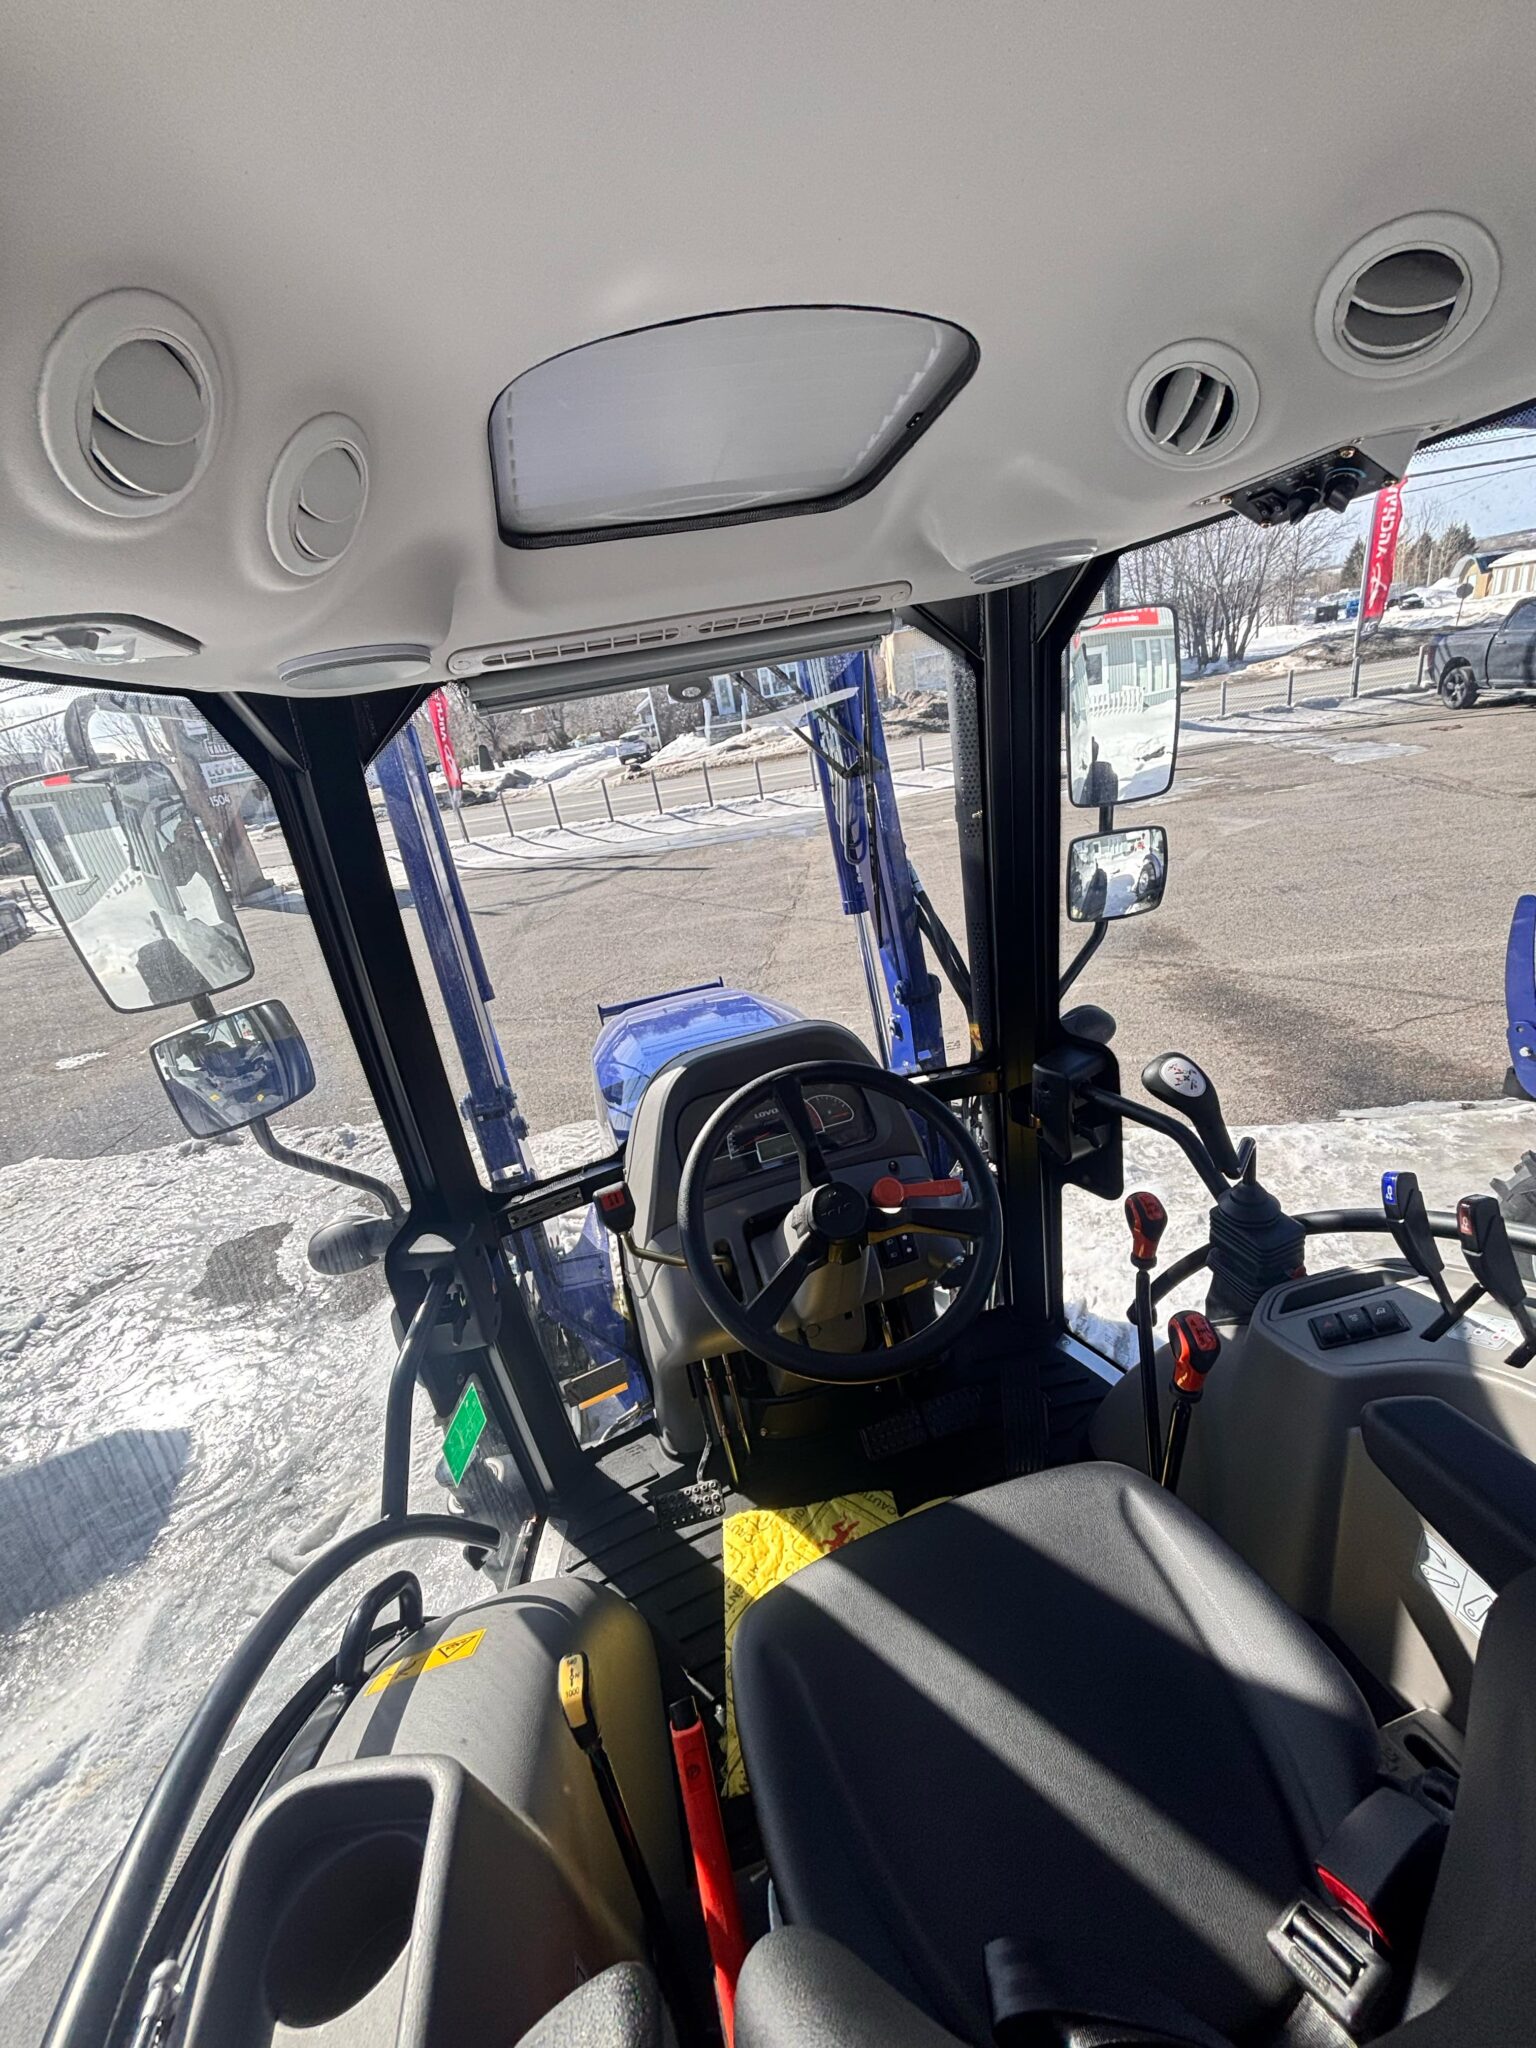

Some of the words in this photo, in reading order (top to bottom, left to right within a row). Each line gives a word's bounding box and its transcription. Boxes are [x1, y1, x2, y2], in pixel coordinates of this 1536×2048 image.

[209, 794, 231, 807] 1504
[754, 1107, 779, 1119] LOVO
[565, 1687, 580, 1698] 1000
